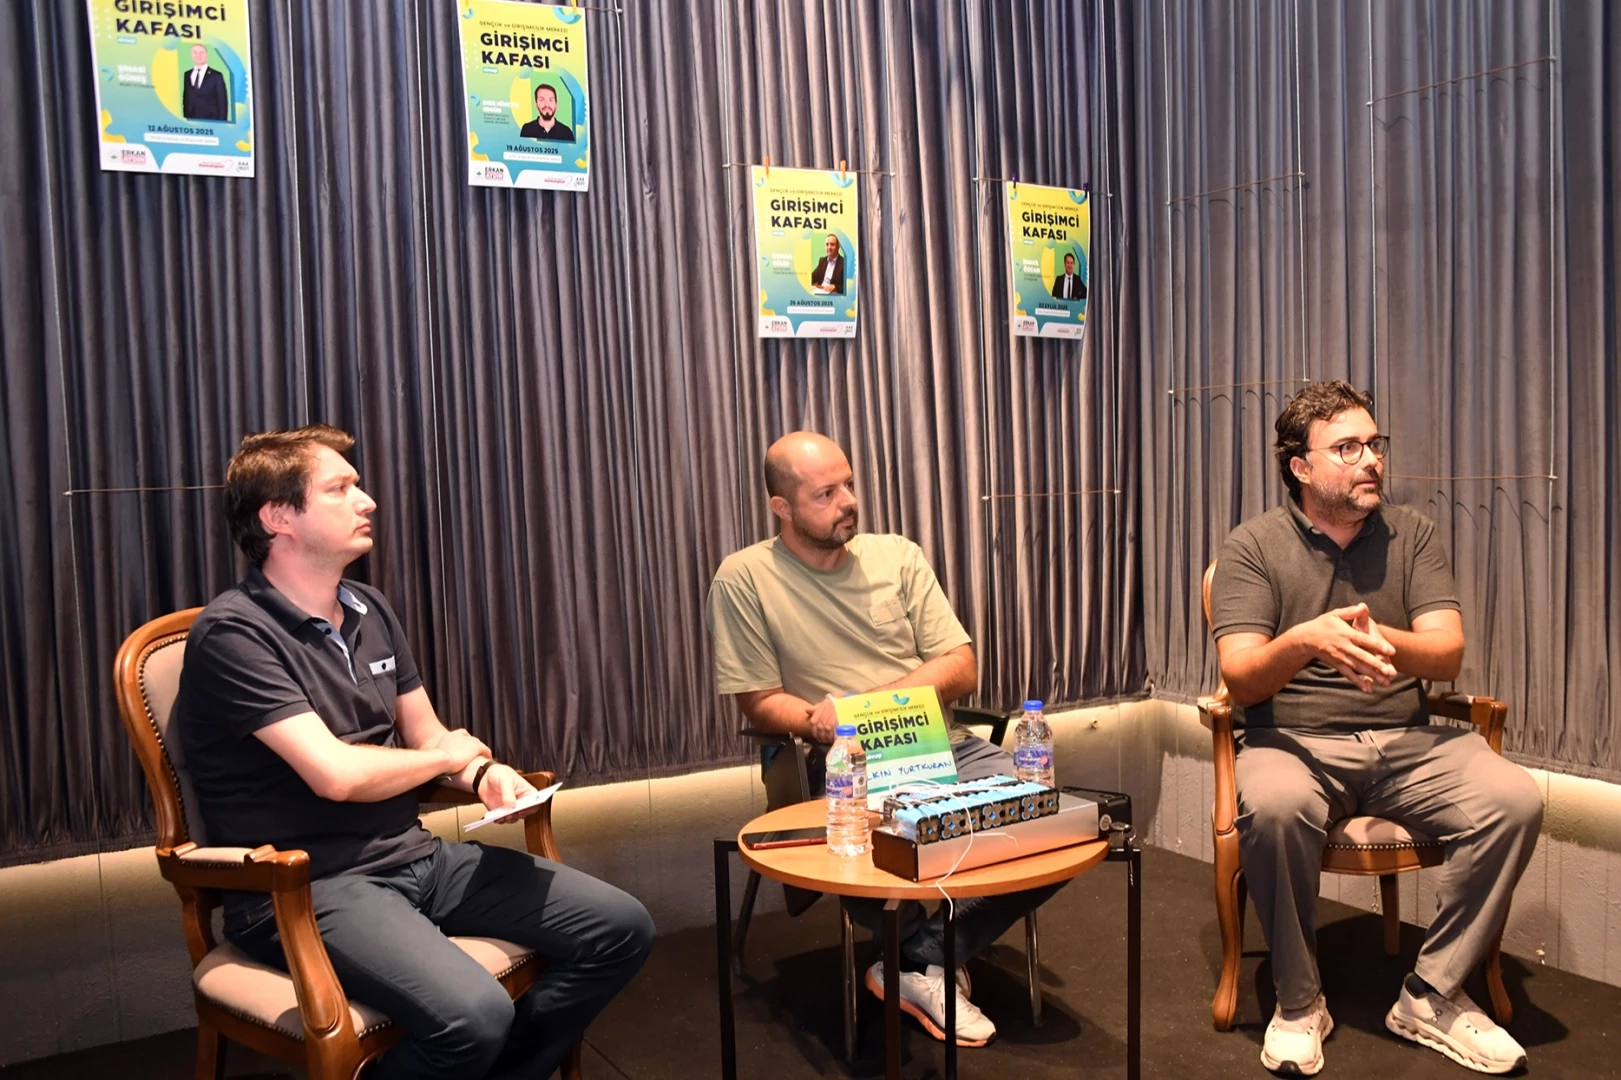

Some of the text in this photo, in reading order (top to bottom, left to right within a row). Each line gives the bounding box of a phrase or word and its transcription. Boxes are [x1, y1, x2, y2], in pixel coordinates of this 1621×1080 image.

[116, 19, 201, 39] KAFASI
[480, 30, 569, 53] GİRİŞİMCİ
[482, 51, 549, 68] KAFASI
[157, 125, 194, 135] AĞUSTOS
[514, 145, 543, 153] AĞUSTOS
[771, 197, 843, 214] GİRİŞİMCİ
[771, 216, 827, 229] KAFASI
[1022, 210, 1079, 227] GİRİŞİMCİ
[1023, 226, 1067, 240] KAFASI
[857, 712, 929, 735] GİRİŞİMCİ
[860, 732, 918, 751] KAFASI
[898, 760, 952, 776] YURTKURAN
